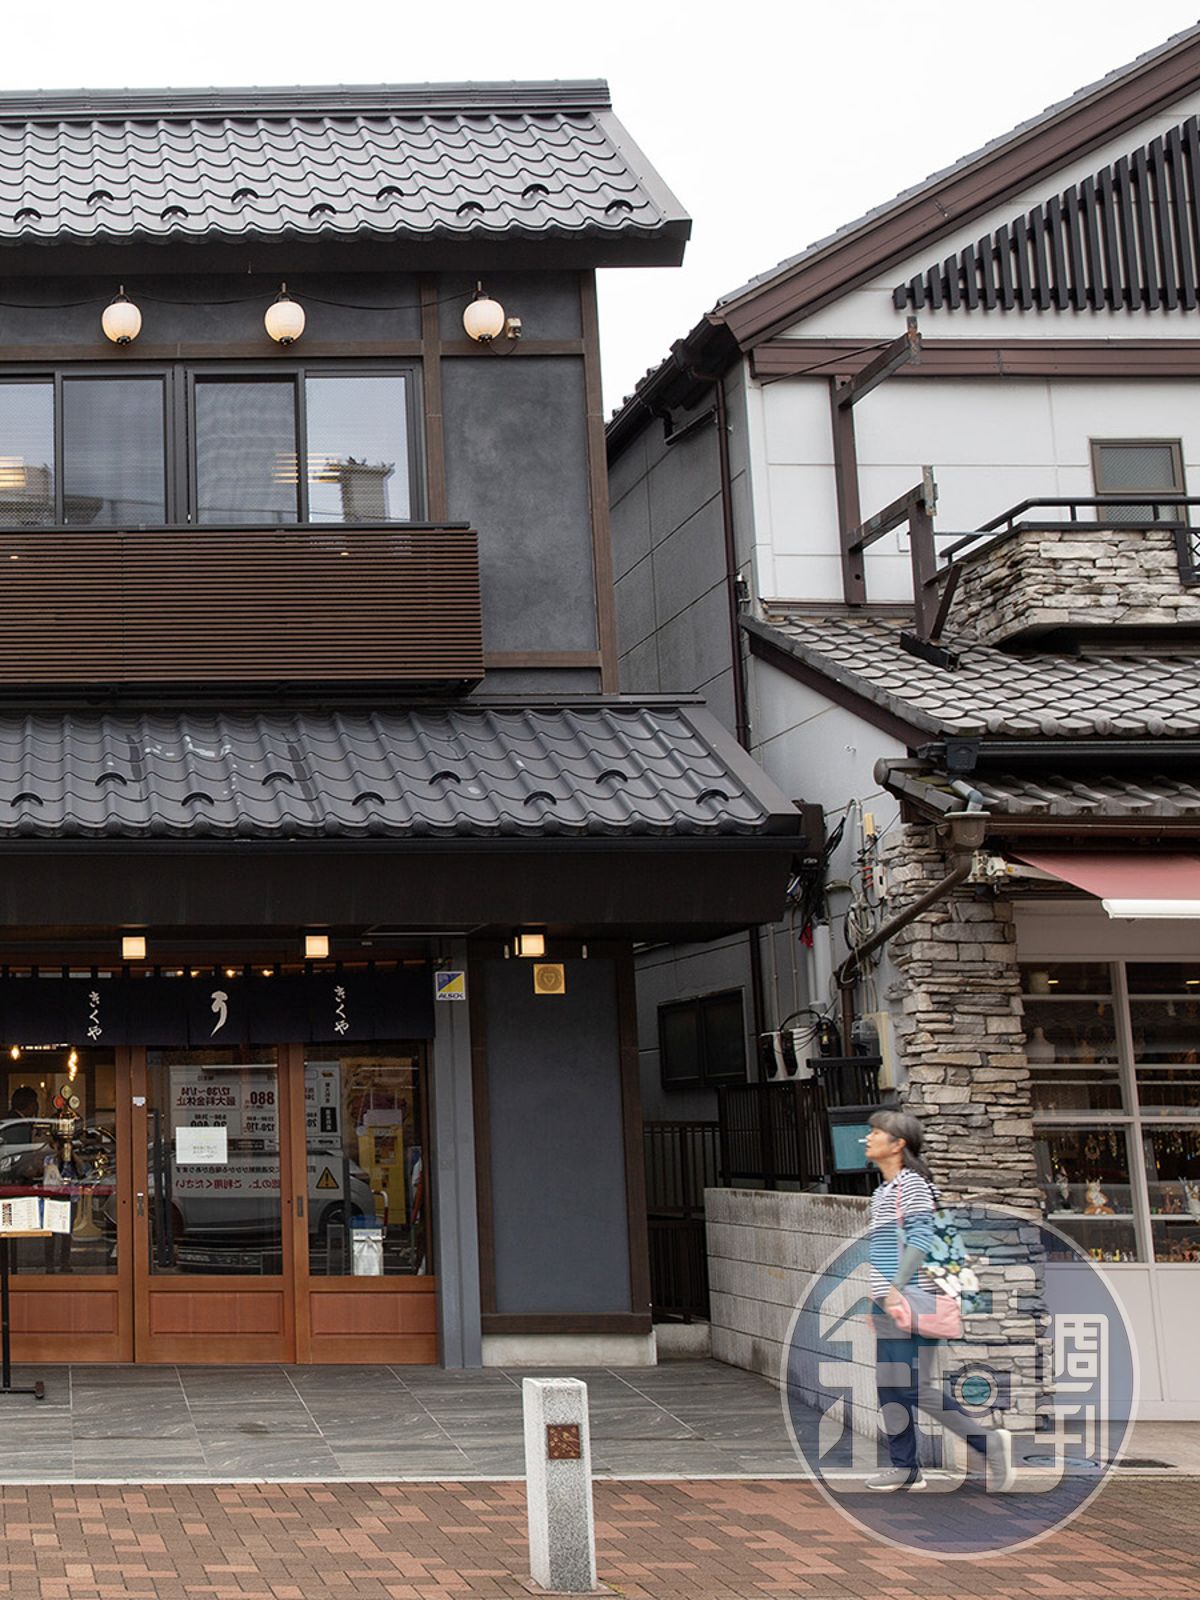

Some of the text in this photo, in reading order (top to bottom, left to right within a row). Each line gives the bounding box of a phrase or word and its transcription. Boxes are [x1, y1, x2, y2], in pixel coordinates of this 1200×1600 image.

[88, 992, 102, 1040] きくや
[335, 986, 349, 1034] きくや
